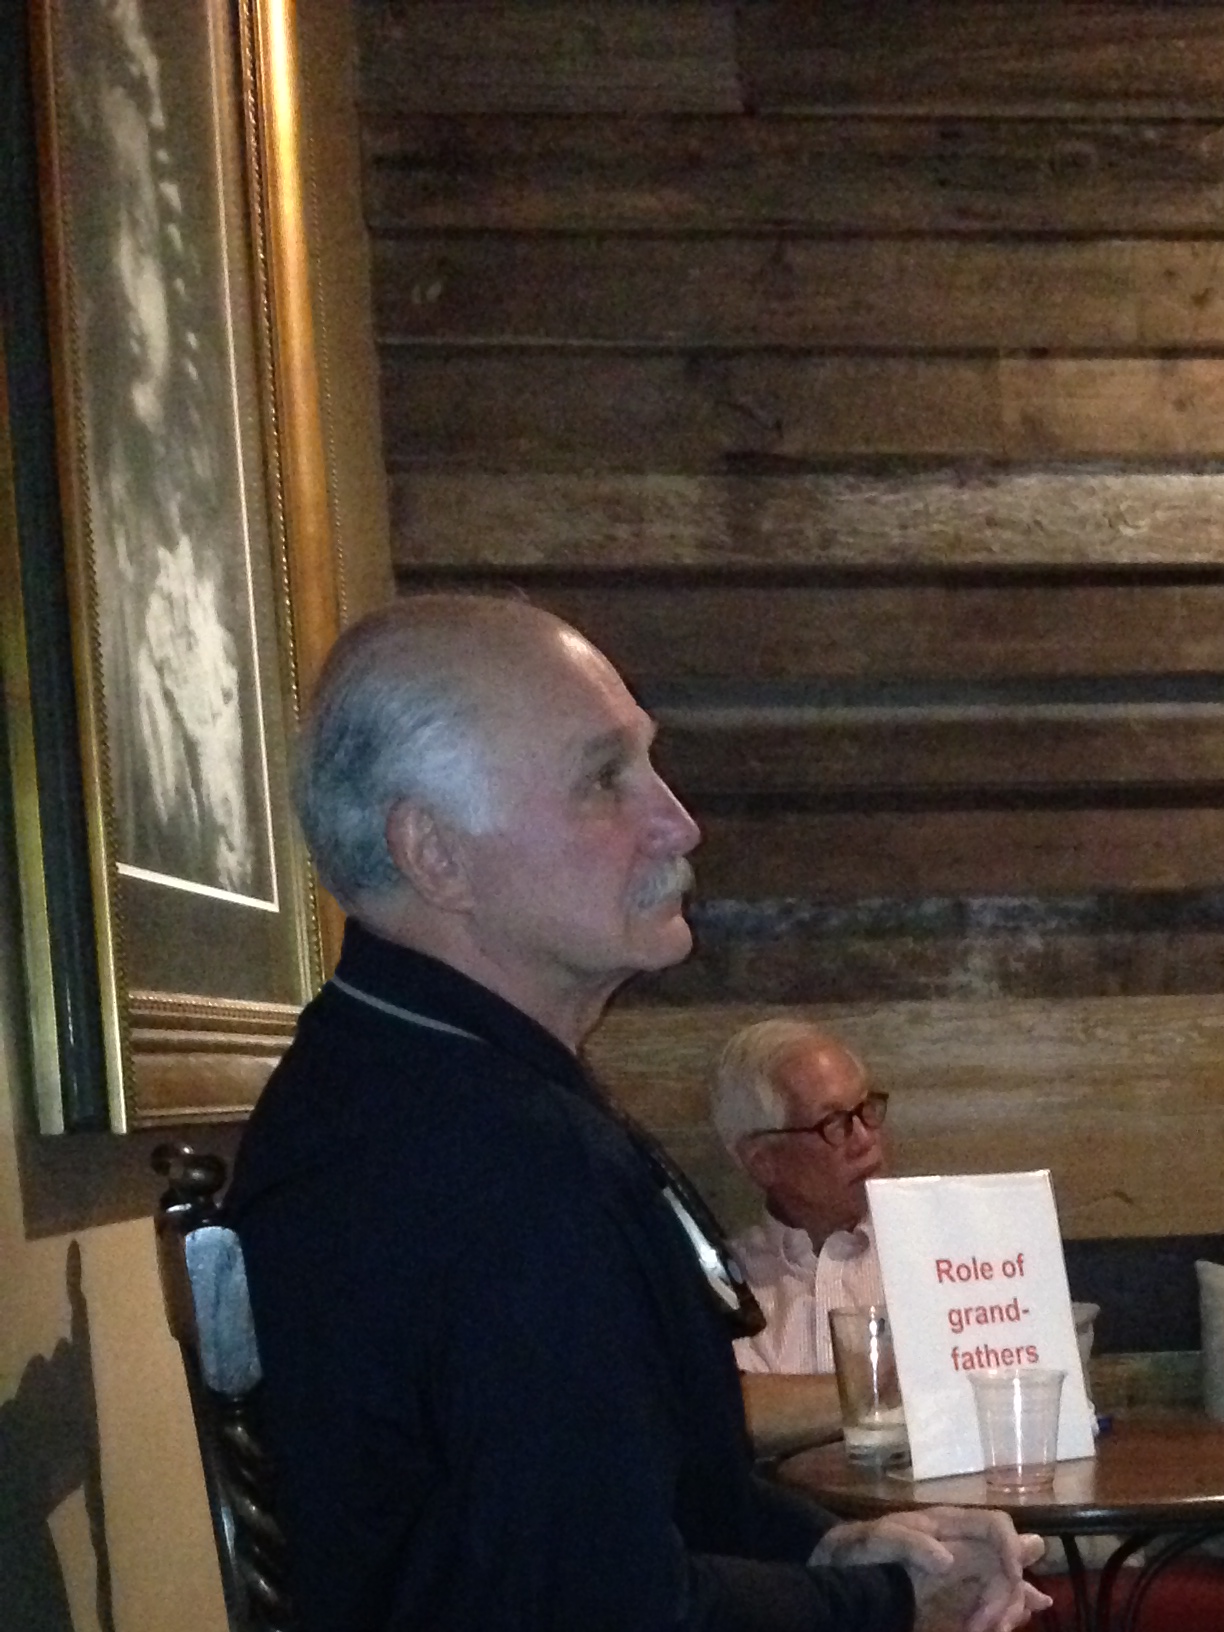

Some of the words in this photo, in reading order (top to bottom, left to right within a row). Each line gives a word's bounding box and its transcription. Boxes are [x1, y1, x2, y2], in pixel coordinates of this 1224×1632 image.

[935, 1256, 993, 1283] Role
[1002, 1253, 1024, 1278] of
[947, 1297, 1030, 1333] grand-
[951, 1343, 1039, 1371] fathers
